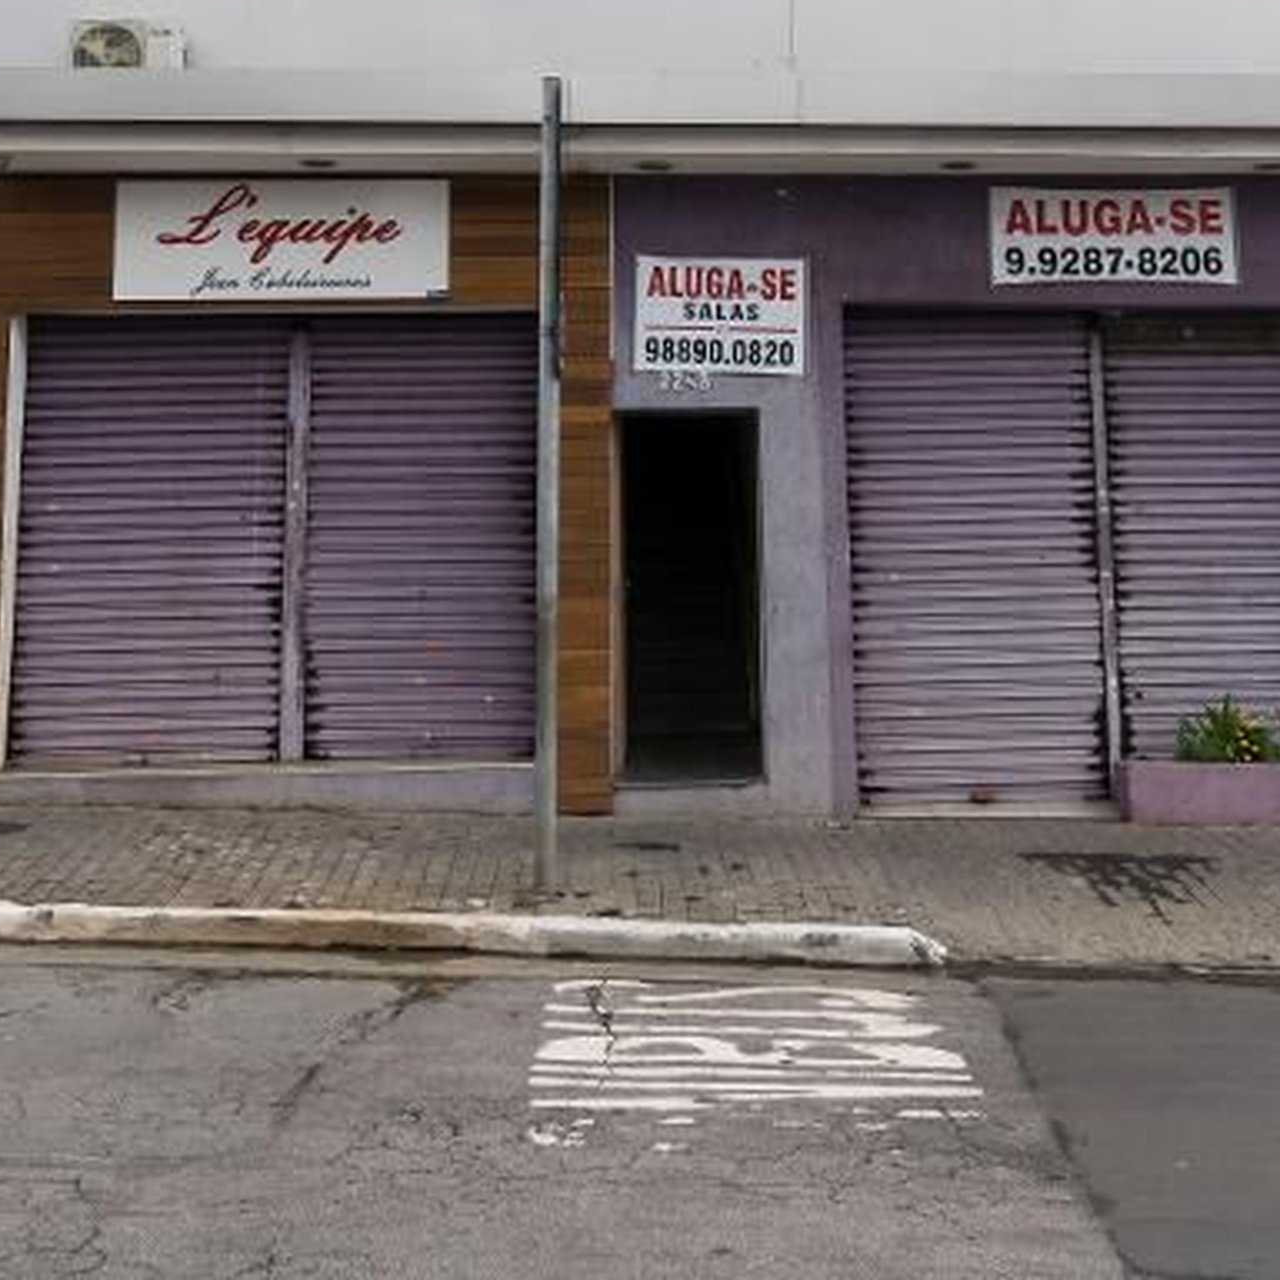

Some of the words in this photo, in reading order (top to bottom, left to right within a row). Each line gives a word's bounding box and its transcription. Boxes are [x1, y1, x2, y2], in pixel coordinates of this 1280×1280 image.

[155, 184, 402, 265] L'equipe
[1005, 198, 1225, 237] ALUGA-SE
[646, 265, 797, 302] ALUGA-SE
[682, 302, 761, 322] SALAS
[644, 336, 796, 368] 98890.0820
